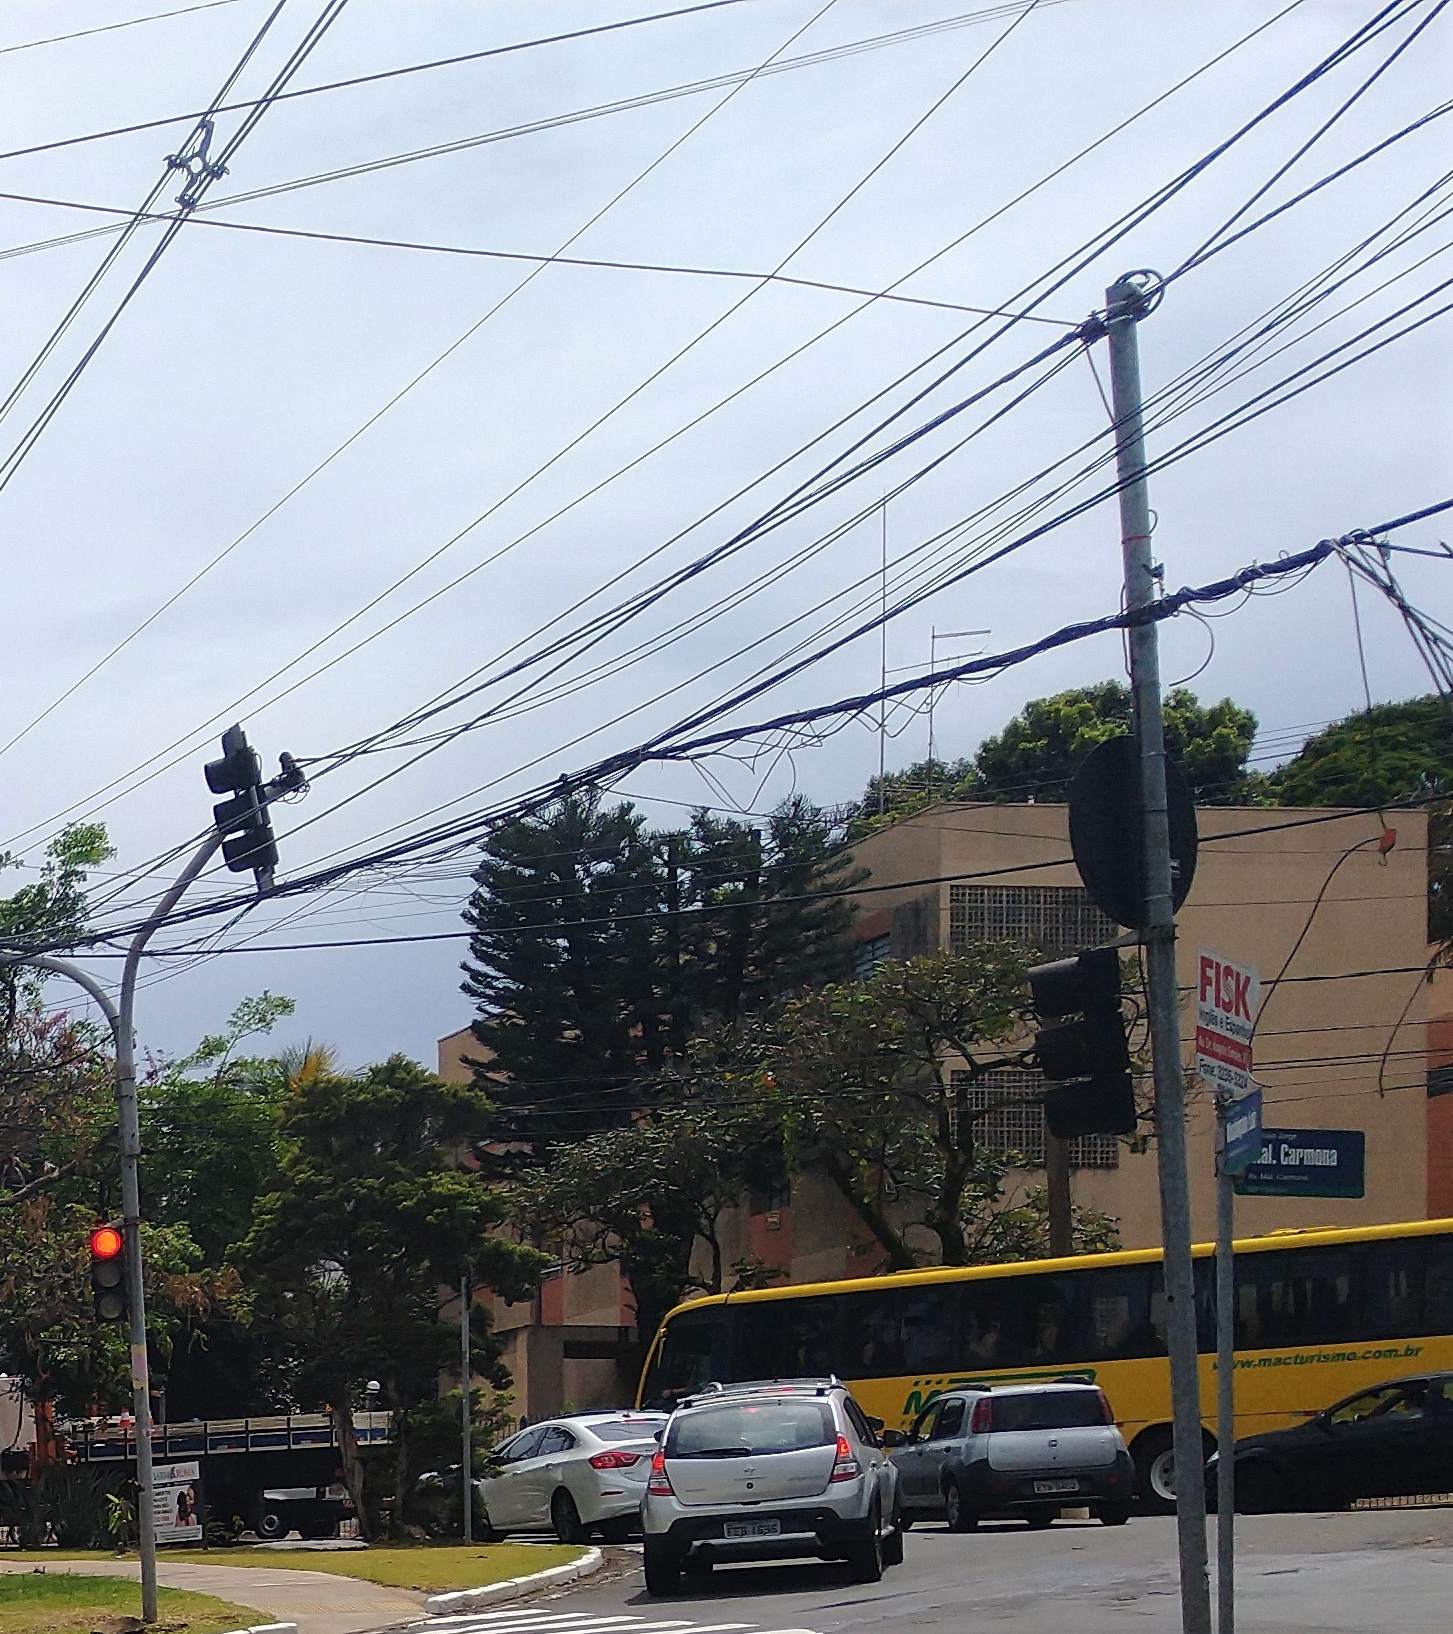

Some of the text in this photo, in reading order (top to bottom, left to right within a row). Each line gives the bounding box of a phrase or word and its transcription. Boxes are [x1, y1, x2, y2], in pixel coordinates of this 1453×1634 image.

[1199, 955, 1252, 1022] FISK
[1253, 1143, 1277, 1165] al.
[1280, 1144, 1338, 1167] Carmona
